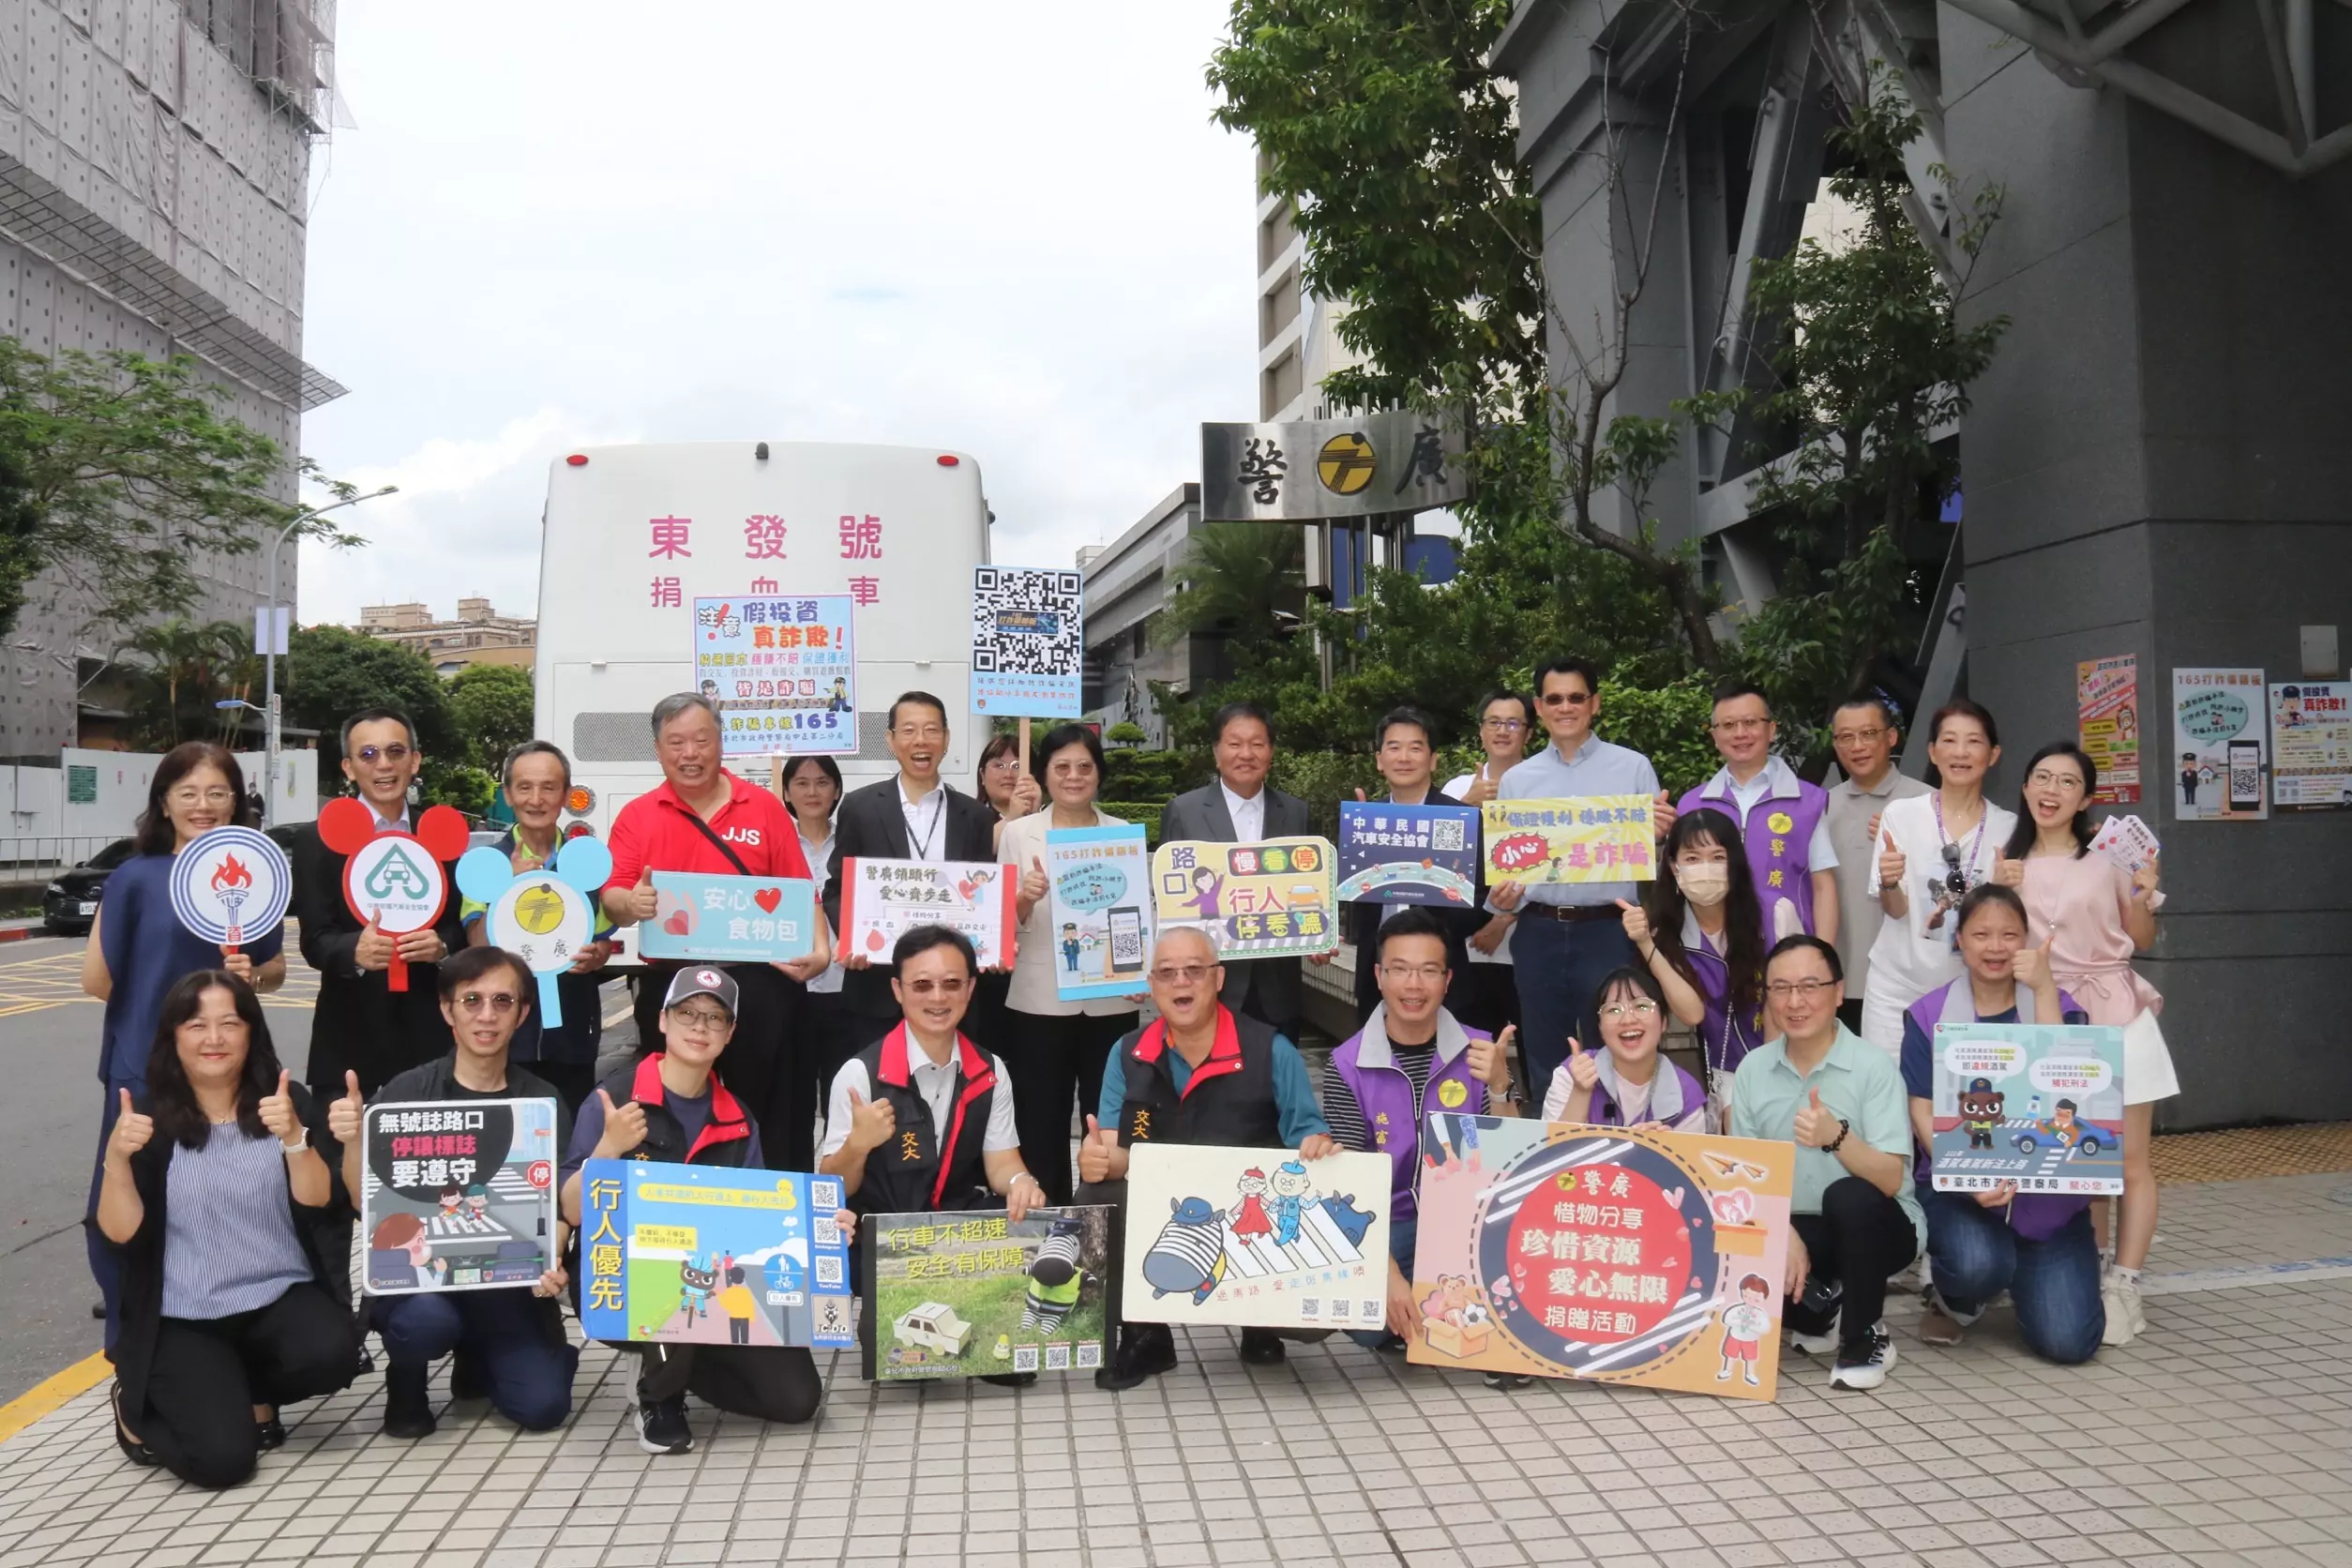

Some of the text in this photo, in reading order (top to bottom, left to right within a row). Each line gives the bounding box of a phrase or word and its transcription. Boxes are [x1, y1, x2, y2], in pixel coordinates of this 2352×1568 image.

[649, 515, 882, 560] 東發號
[743, 601, 819, 624] 假投資
[736, 679, 816, 697] 皆是詐騙
[721, 826, 761, 846] JJS
[1352, 816, 1429, 834] 中華民國
[1351, 832, 1429, 849] 汽車安全協會
[1501, 840, 1539, 866] 小心
[1567, 840, 1650, 869] 是詐騙
[1233, 848, 1316, 873] 慢看停
[1767, 837, 1787, 889] 警廣
[703, 887, 751, 912] 安心
[879, 885, 953, 903] 愛心齊步走
[1229, 885, 1285, 914] 行人
[728, 916, 799, 942] 食物包
[1235, 912, 1323, 940] 停看聽
[378, 1110, 484, 1133] 無號誌路口
[1132, 1109, 1151, 1139] 交大
[1375, 1111, 1390, 1153] 施富
[391, 1134, 477, 1157] 停讓標誌
[901, 1131, 921, 1161] 交大
[391, 1157, 477, 1188] 要遵守
[533, 1167, 550, 1184] 停
[1581, 1169, 1633, 1198] 警廣
[1553, 1200, 1644, 1229] 惜物分享
[588, 1178, 624, 1311] 行人優先
[889, 1217, 1009, 1252] 行車不超速
[1520, 1229, 1641, 1266] 珍惜資源
[907, 1246, 1025, 1279] 安全有保障
[1547, 1269, 1668, 1304] 愛心無限
[1543, 1305, 1636, 1335] 捐贈活動
